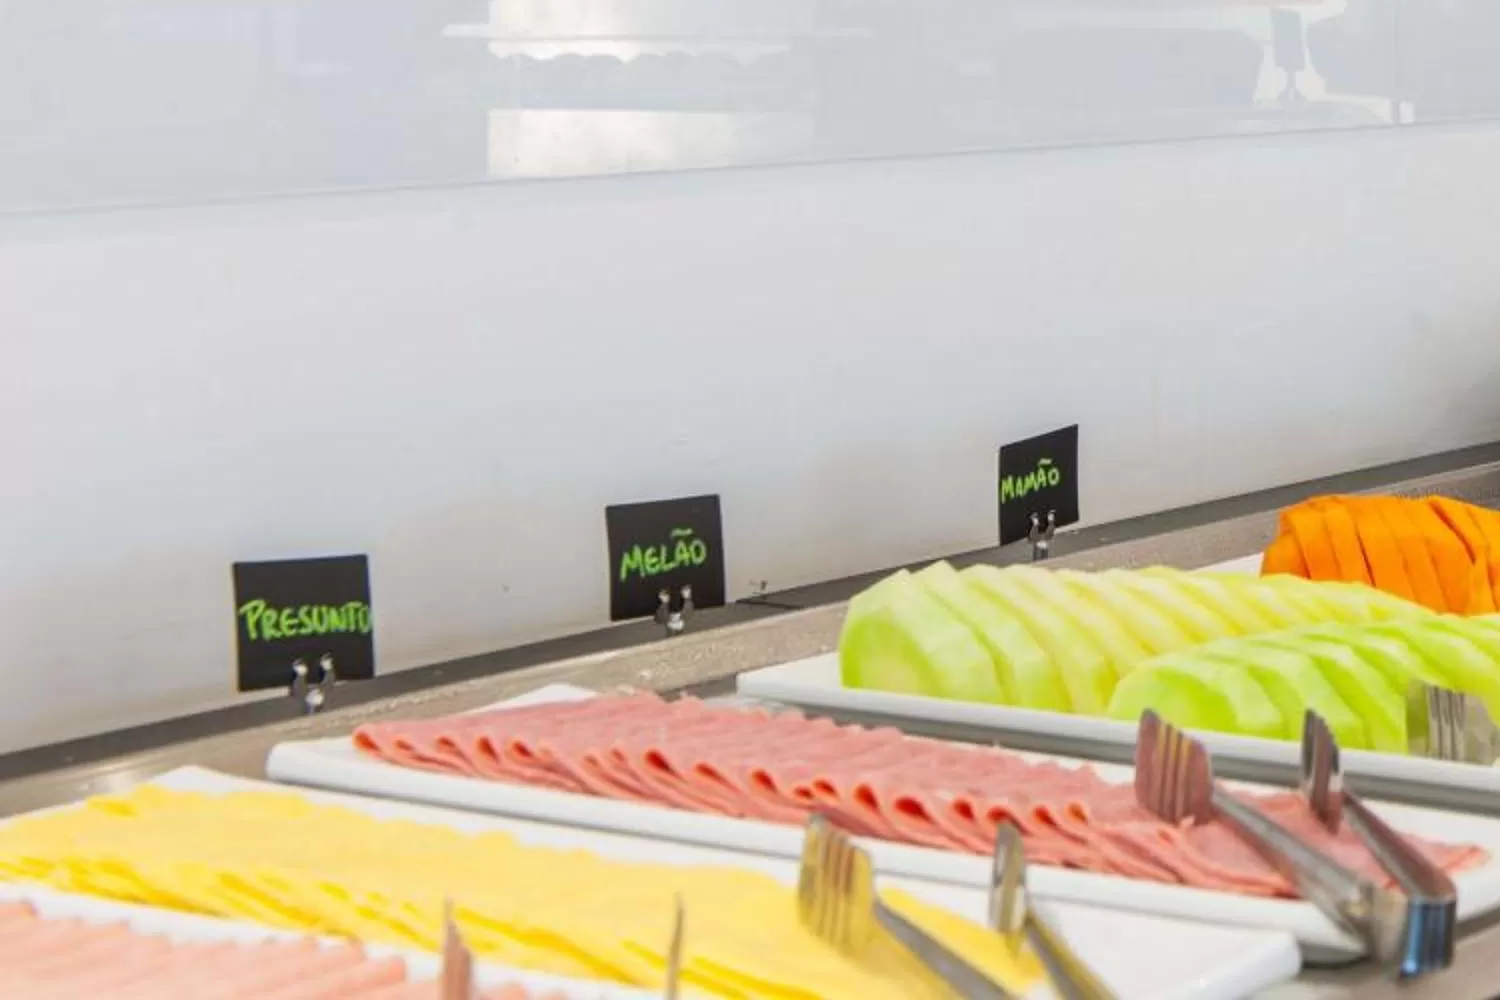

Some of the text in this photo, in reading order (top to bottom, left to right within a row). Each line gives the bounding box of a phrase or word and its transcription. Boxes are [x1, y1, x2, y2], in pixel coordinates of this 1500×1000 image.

[1001, 458, 1060, 504] MAMÃO
[619, 527, 707, 582] MELÃO
[239, 598, 373, 640] PRESUNTO
